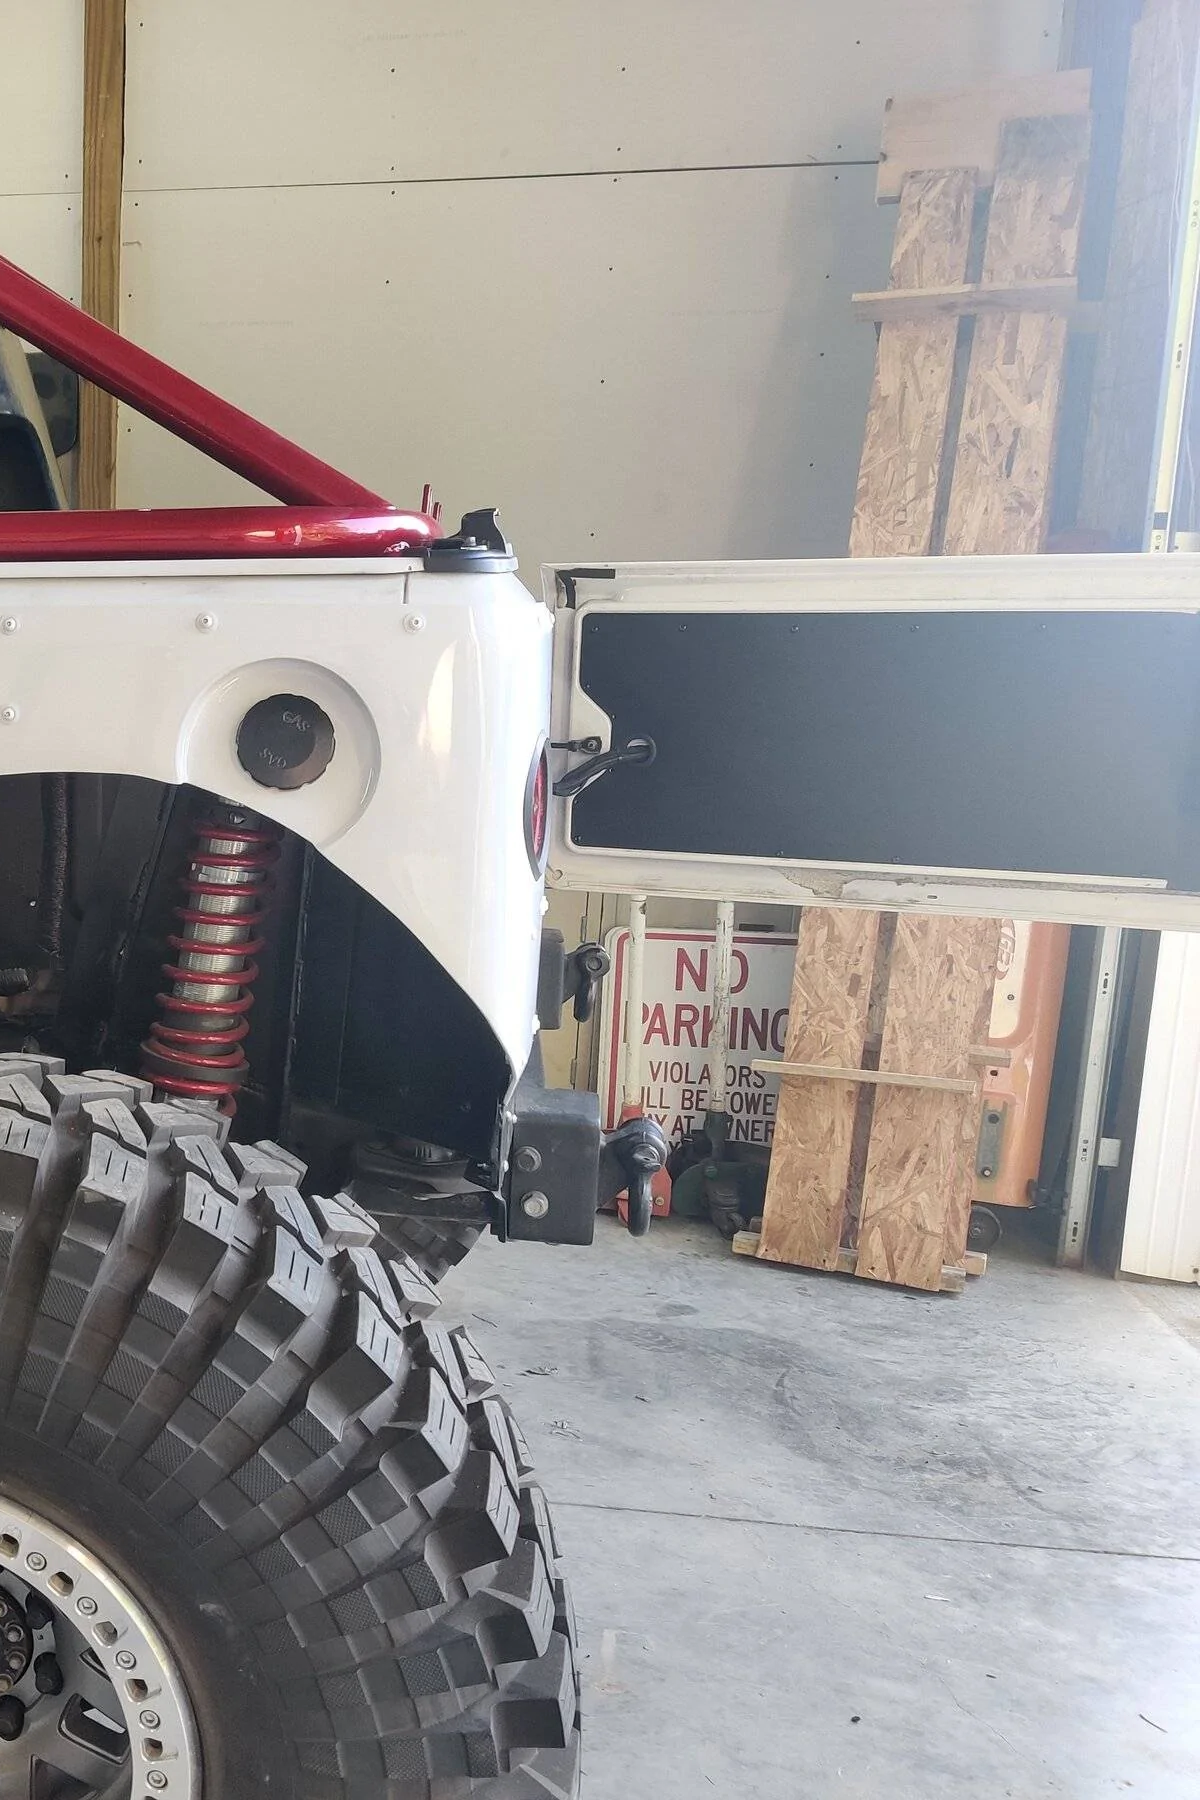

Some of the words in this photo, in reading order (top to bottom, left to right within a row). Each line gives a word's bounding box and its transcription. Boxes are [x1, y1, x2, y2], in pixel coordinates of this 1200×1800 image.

[649, 1060, 766, 1089] VIOLAORS
[623, 1085, 670, 1110] ILL
[681, 1088, 709, 1112] BE
[726, 1091, 779, 1116] OWE
[671, 1114, 695, 1137] AT
